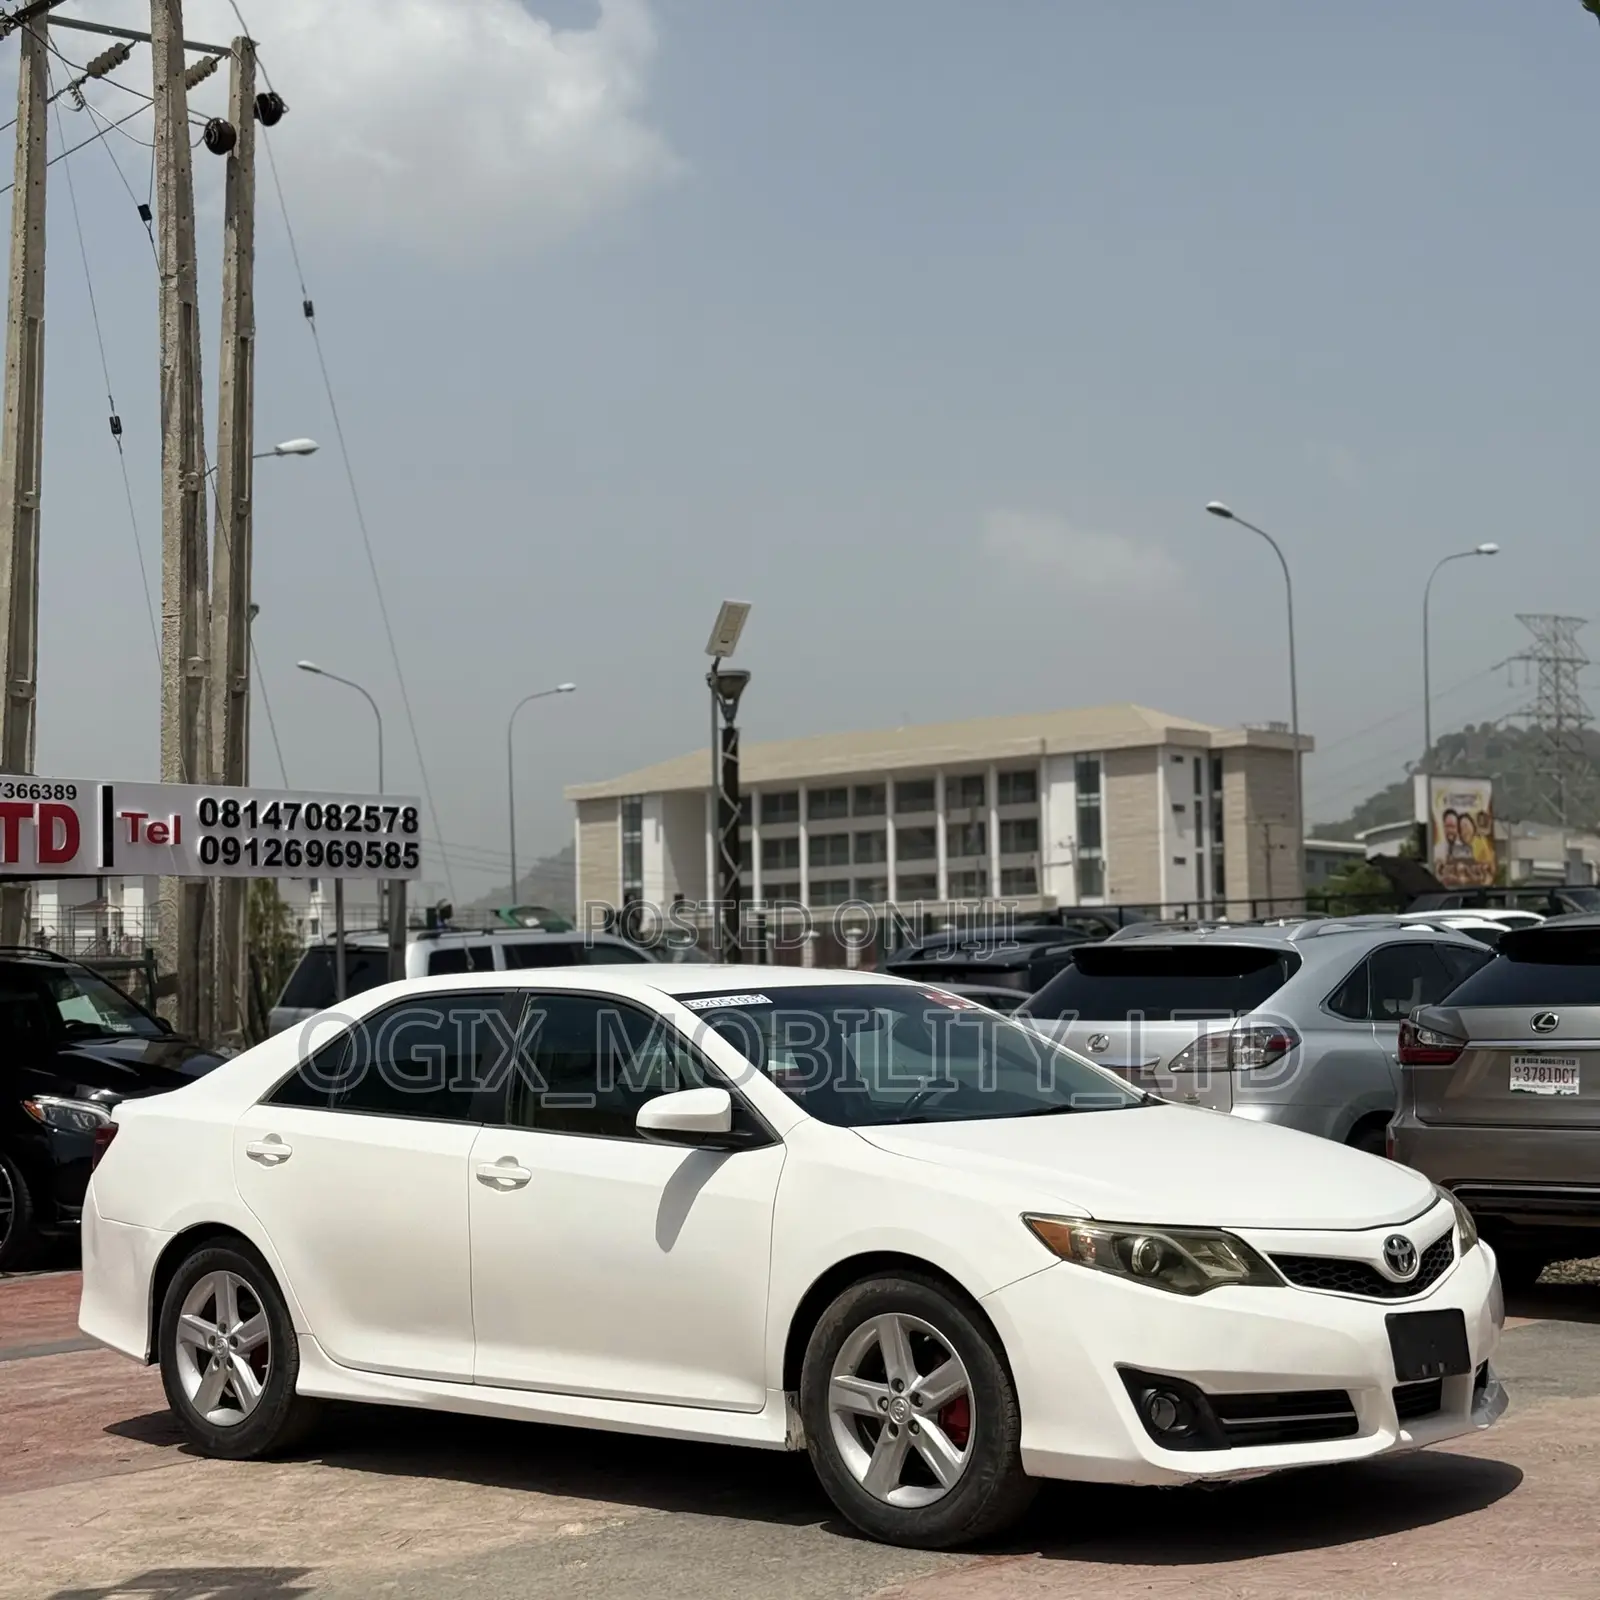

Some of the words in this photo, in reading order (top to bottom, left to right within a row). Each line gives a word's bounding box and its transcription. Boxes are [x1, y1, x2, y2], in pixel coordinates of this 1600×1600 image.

[0, 783, 77, 800] 366389
[0, 802, 80, 863] TD
[118, 811, 181, 845] Tel
[198, 797, 419, 834] 08147082578
[198, 835, 420, 869] 09126969585
